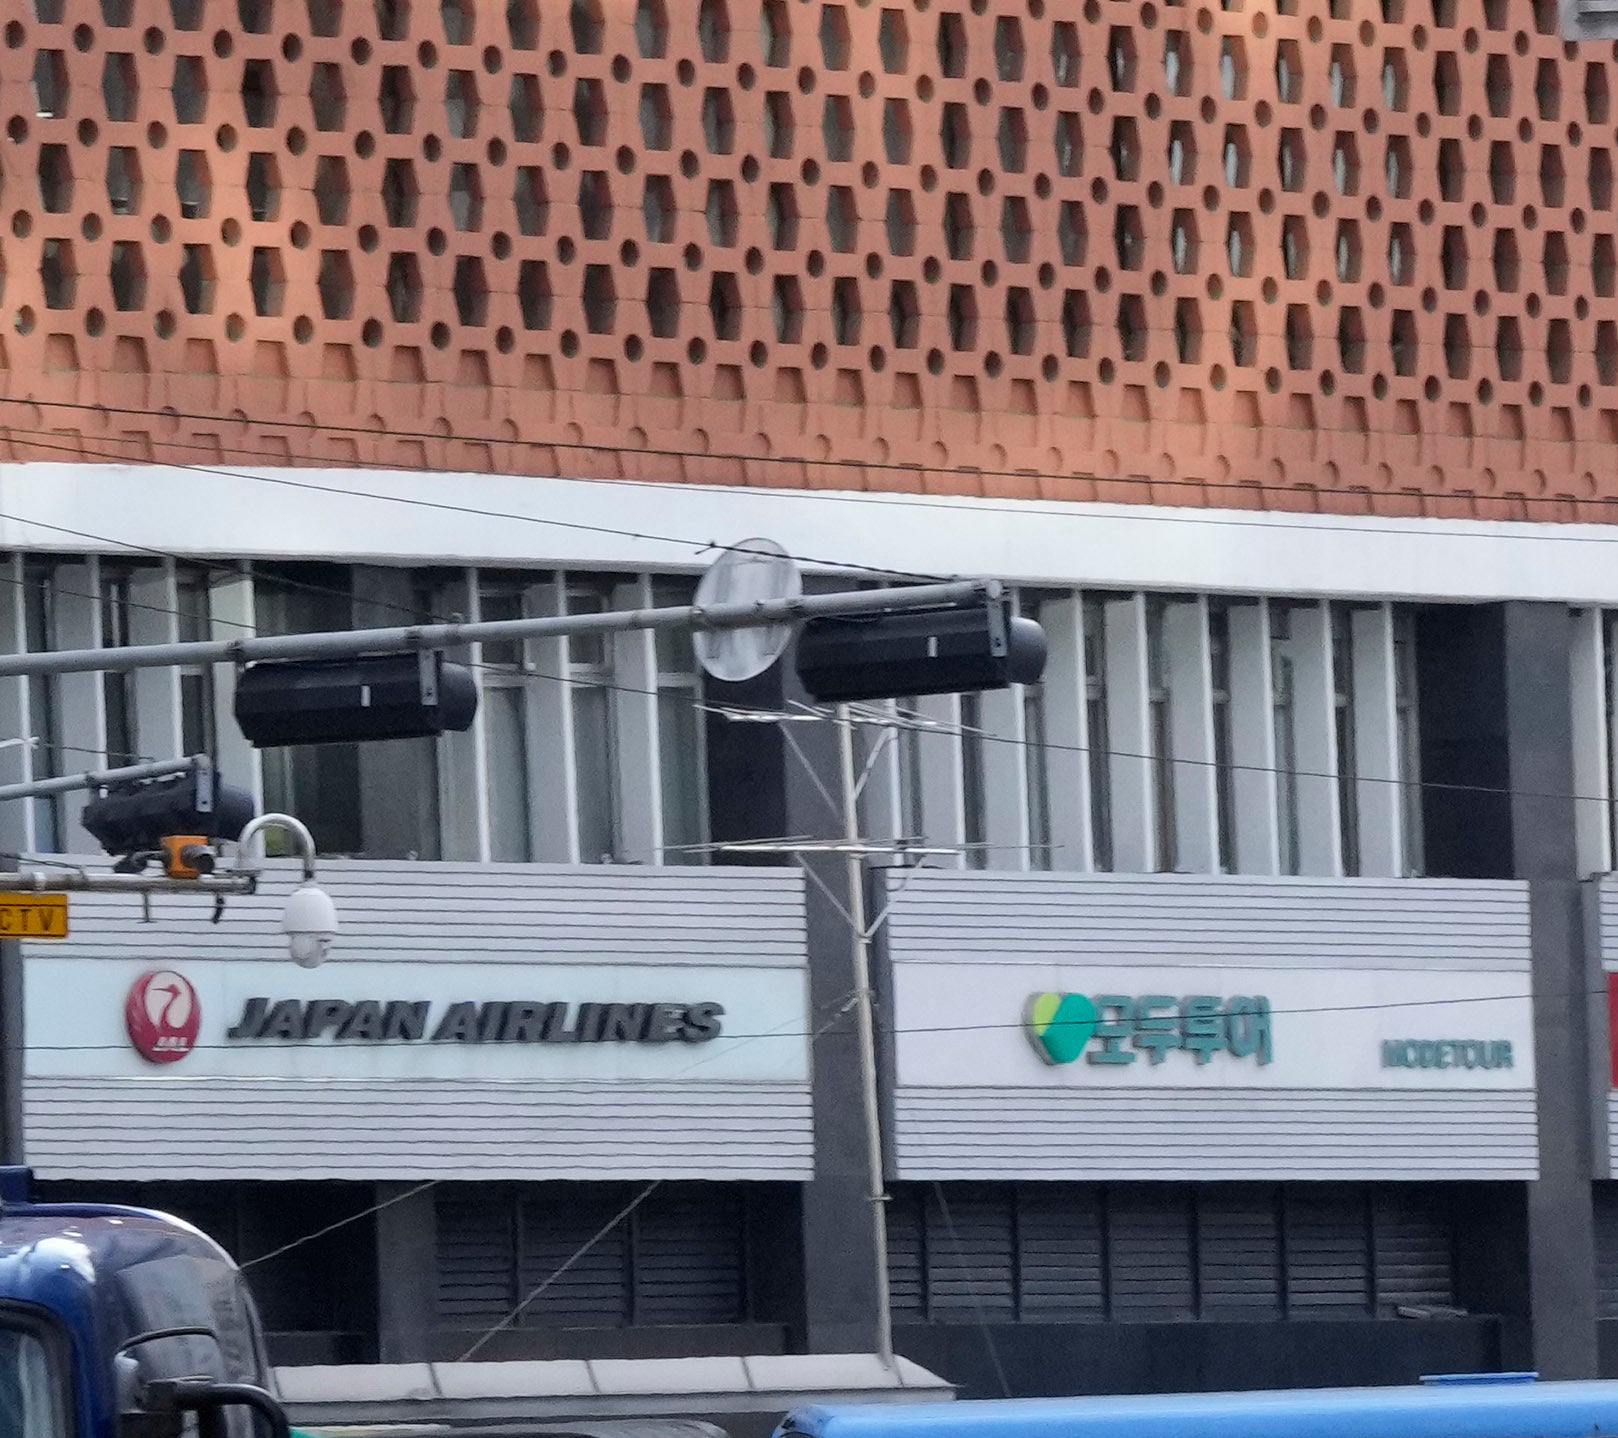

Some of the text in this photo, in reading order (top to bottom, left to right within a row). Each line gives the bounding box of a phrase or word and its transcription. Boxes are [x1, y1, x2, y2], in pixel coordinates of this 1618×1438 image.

[227, 998, 726, 1043] JAPAN AIRLINES
[1087, 994, 1272, 1065] 모두투어
